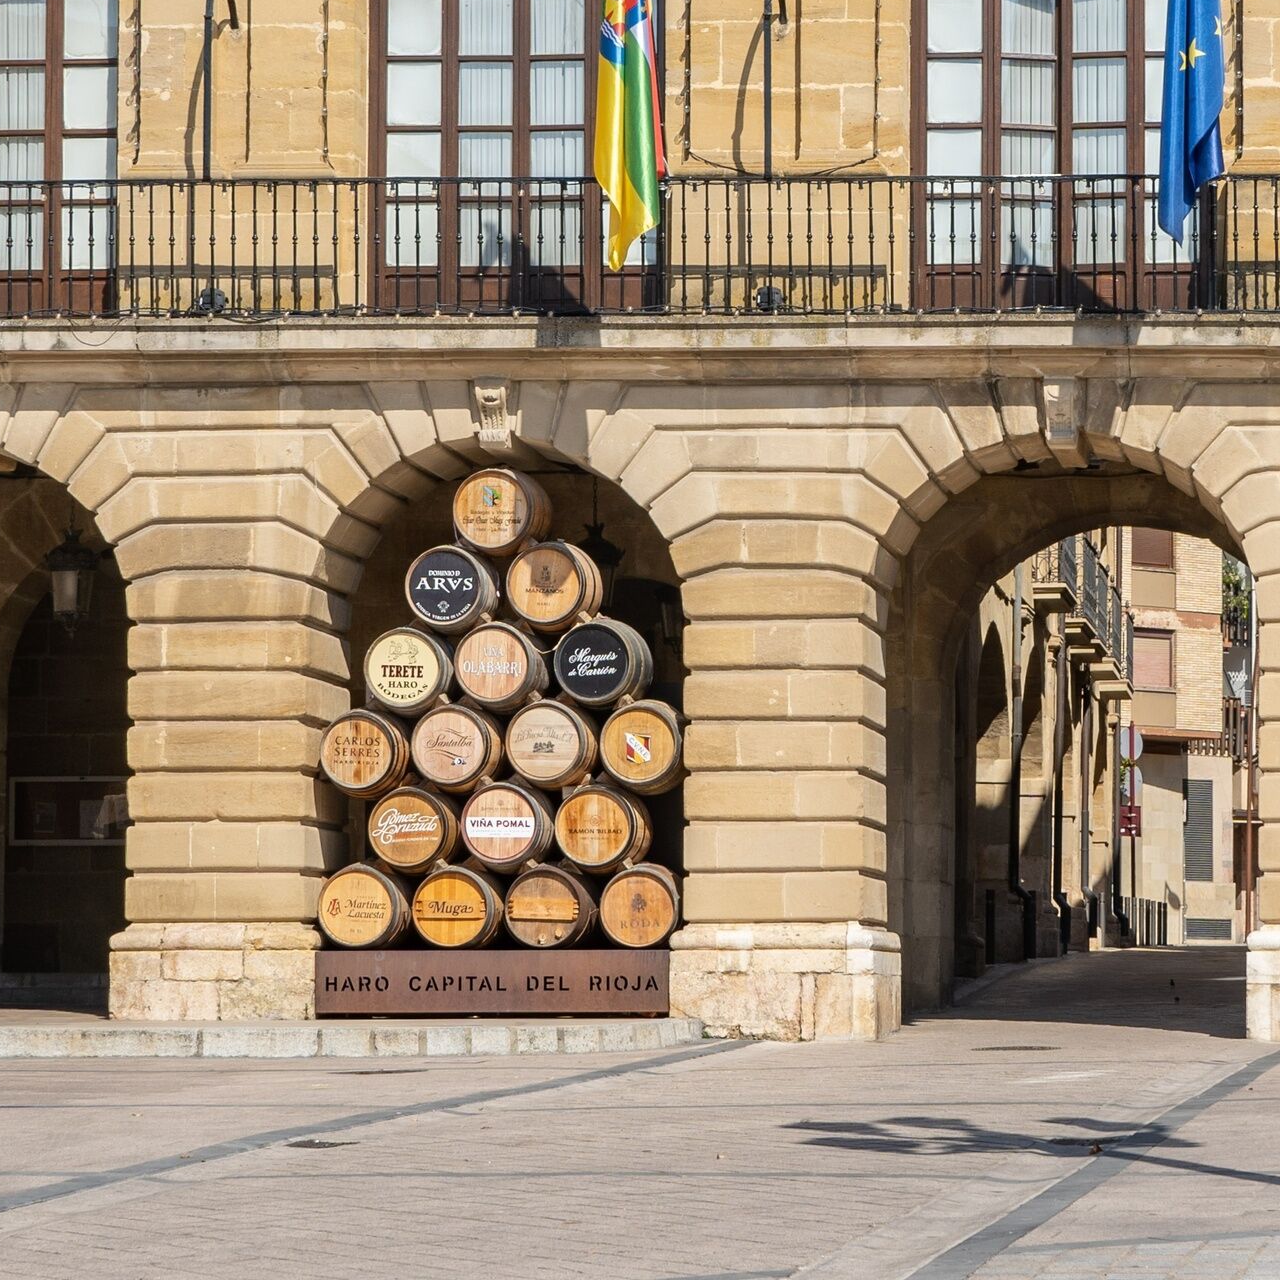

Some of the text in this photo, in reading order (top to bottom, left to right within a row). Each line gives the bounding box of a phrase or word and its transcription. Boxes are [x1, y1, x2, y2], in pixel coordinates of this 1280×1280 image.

[380, 664, 424, 678] TERETE
[463, 660, 522, 677] OLABARRI
[377, 683, 428, 700] BODEGAS
[334, 736, 381, 746] CARLOS
[334, 747, 380, 758] SERRES
[470, 818, 531, 828] VIÑA POMAL
[344, 898, 387, 910] Martínez
[427, 901, 474, 916] Muga
[347, 909, 385, 919] Lacuesta
[620, 919, 660, 929] RODA
[324, 975, 660, 992] HARO CAPITAL DEL RIOJA
